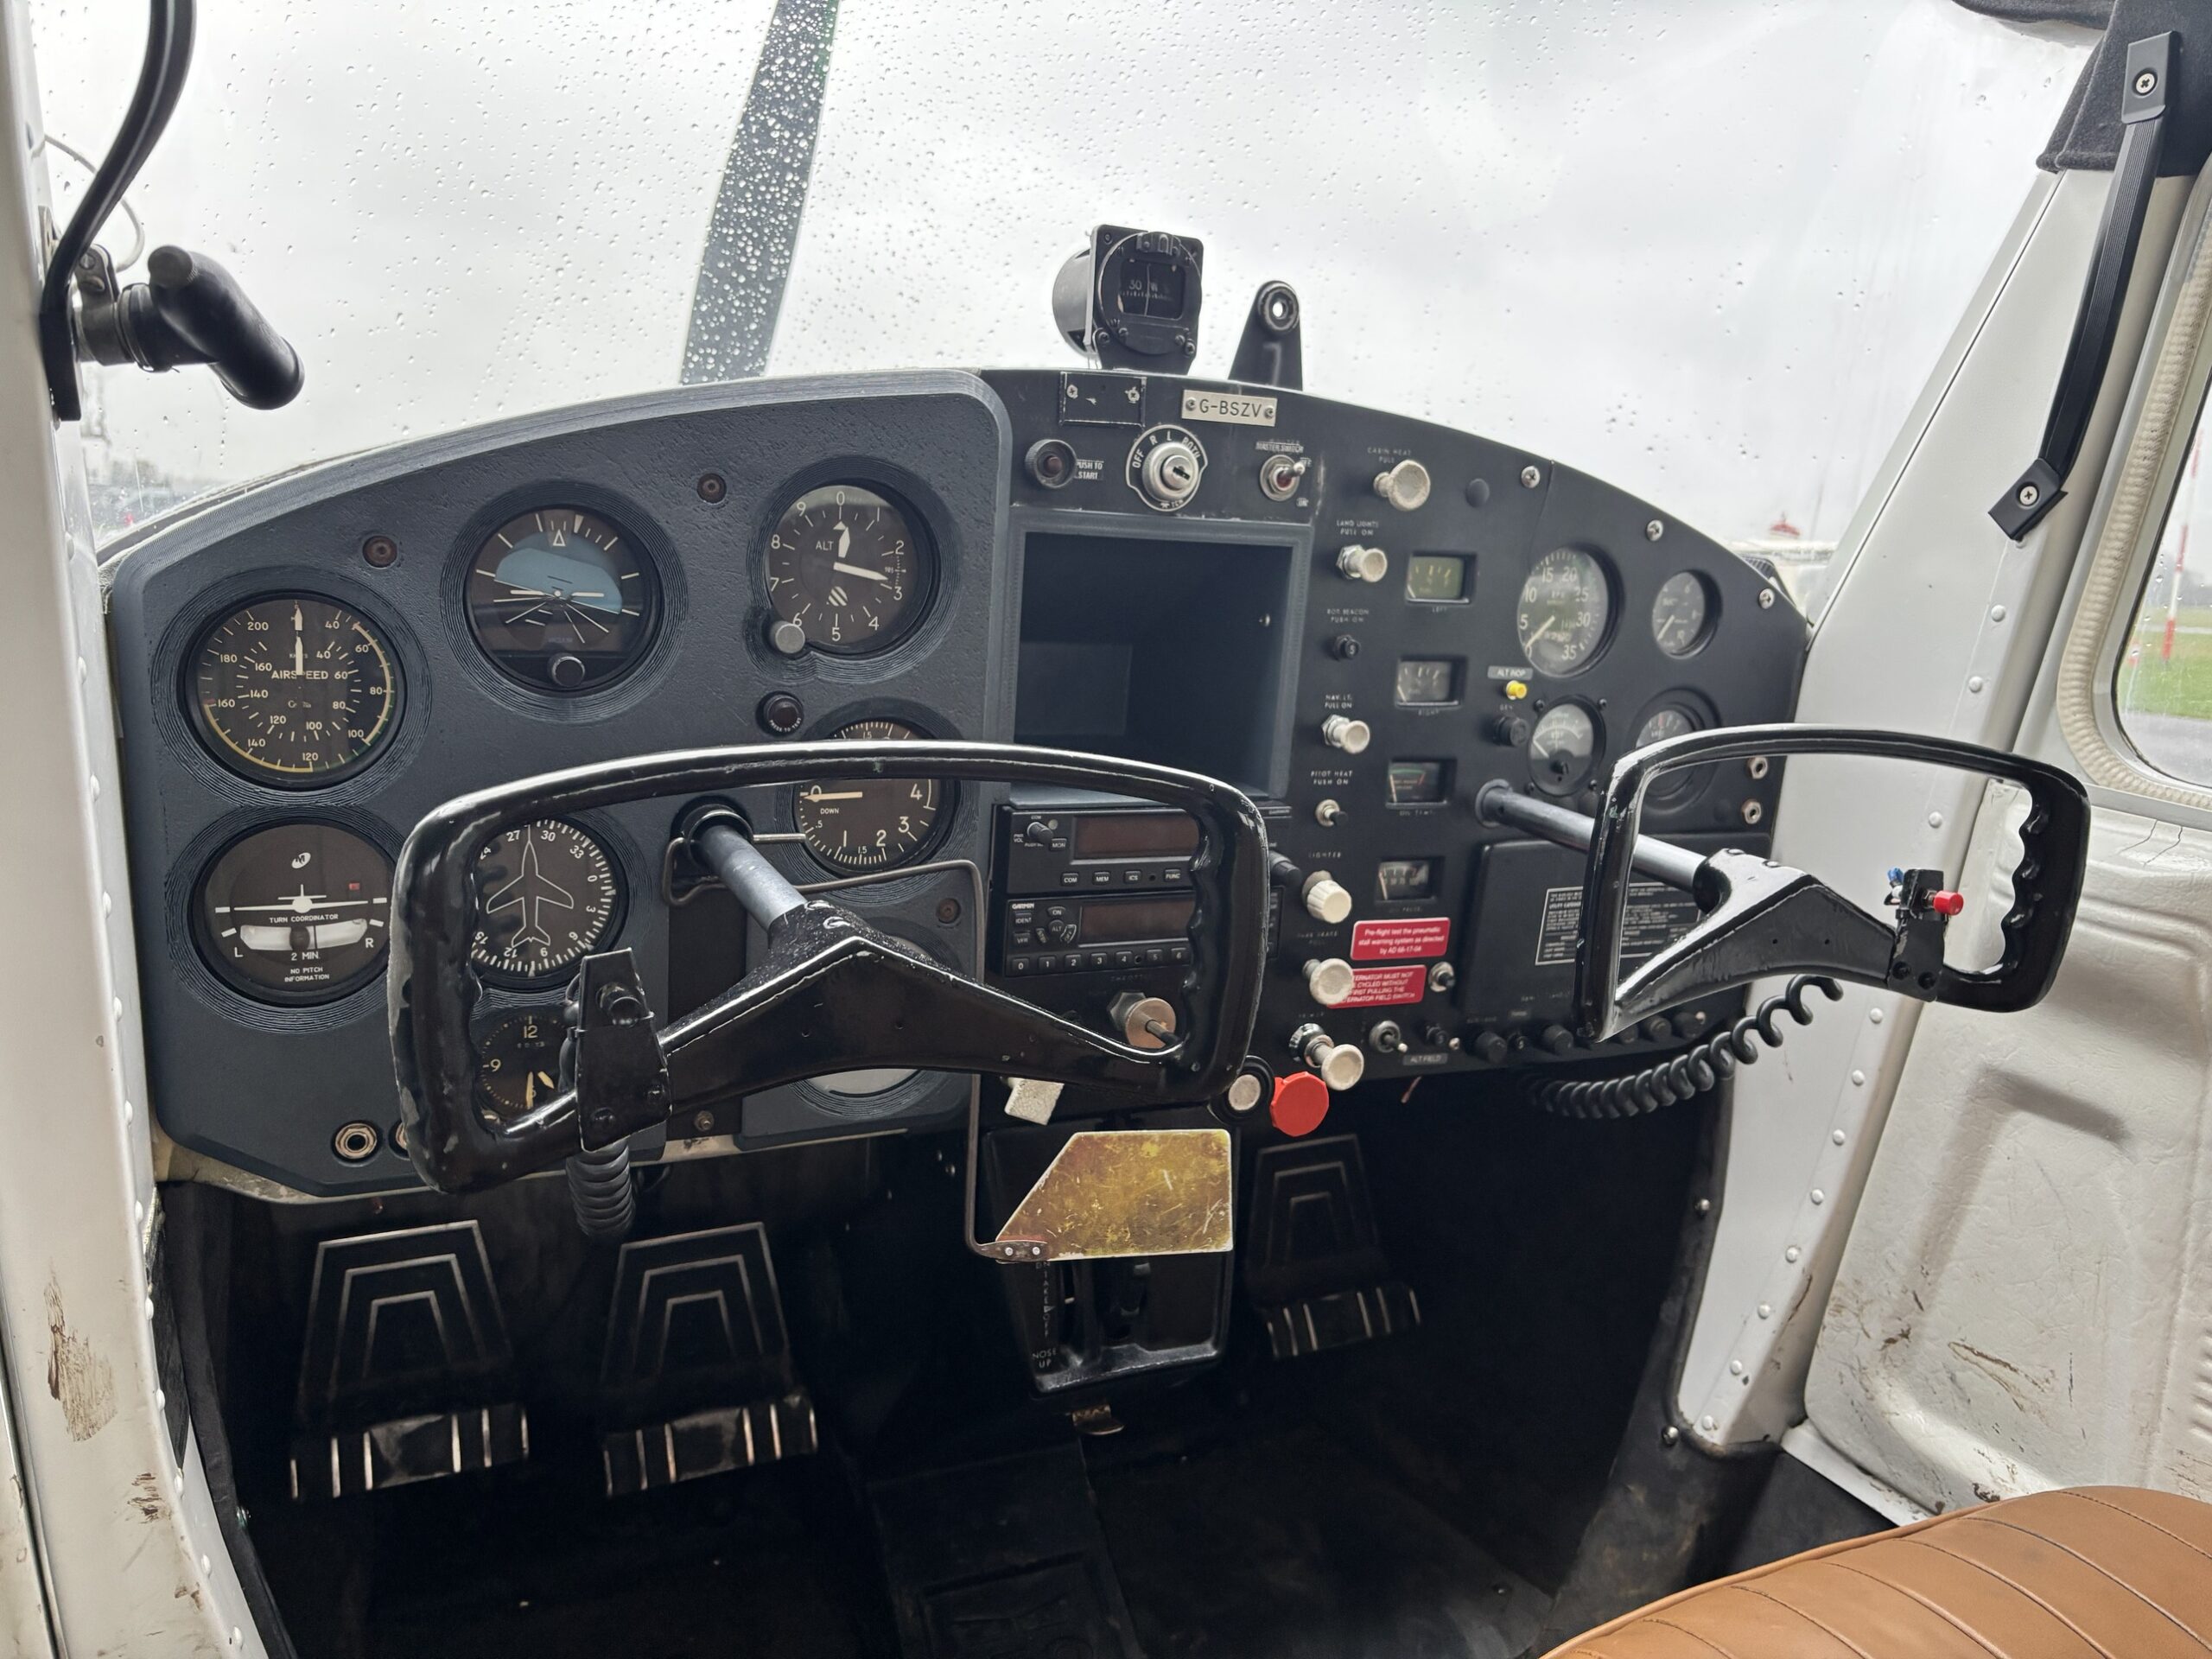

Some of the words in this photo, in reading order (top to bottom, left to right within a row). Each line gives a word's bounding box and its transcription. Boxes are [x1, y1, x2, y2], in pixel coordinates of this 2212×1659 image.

[1128, 280, 1141, 291] 30
[1198, 399, 1263, 418] G-BSZV
[1149, 435, 1159, 446] R
[1166, 430, 1173, 442] L
[1181, 435, 1202, 459] BOTH
[1367, 447, 1390, 455] CABIN
[1131, 448, 1145, 468] OFF
[1077, 471, 1098, 480] START
[836, 490, 846, 506] 0
[796, 501, 807, 517] 9
[1336, 519, 1355, 528] LAND
[770, 533, 781, 550] 8
[815, 540, 835, 551] ALT
[894, 540, 905, 556] 2
[1541, 566, 1554, 583] 15
[1561, 566, 1578, 582] 20
[769, 576, 779, 592] 7
[893, 586, 904, 601] 3
[1524, 586, 1538, 603] 10
[1574, 587, 1590, 602] 25
[325, 620, 340, 629] 40
[791, 612, 803, 627] 6
[868, 615, 880, 631] 4
[1519, 613, 1529, 630] 5
[1575, 612, 1591, 627] 30
[247, 621, 269, 631] 200
[831, 626, 842, 642] 5
[355, 644, 369, 652] 60
[1561, 645, 1578, 661] 35
[220, 654, 238, 663] 180
[316, 650, 331, 659] 40
[255, 662, 272, 671] 160
[334, 671, 348, 680] 60
[370, 686, 383, 696] 80
[218, 699, 235, 708] 160
[270, 715, 286, 724] 120
[306, 721, 322, 730] 100
[347, 729, 364, 738] 100
[248, 739, 266, 747] 140
[302, 753, 319, 761] 120
[910, 783, 923, 801] 4
[898, 816, 910, 833] 3
[505, 830, 521, 842] 27
[540, 830, 556, 842] 30
[875, 830, 887, 848] 2
[569, 845, 585, 860] 33
[585, 905, 596, 913] 3
[290, 912, 340, 923] COORDINATOR
[1364, 927, 1391, 937] Pre-flight
[1413, 926, 1441, 935] pneumatic
[365, 938, 374, 949] R
[474, 931, 489, 945] 15
[1394, 938, 1414, 946] system
[1422, 935, 1446, 944] directed
[234, 946, 244, 958] L
[290, 952, 298, 962] 2
[302, 950, 321, 961] MIN.
[503, 946, 518, 958] 12
[1018, 962, 1024, 970] 0
[1071, 958, 1077, 967] 2
[1096, 957, 1103, 965] 3
[283, 974, 330, 982] INFORMATION
[1357, 980, 1381, 988] CYCLED
[1382, 978, 1409, 987] WITHOUT
[1393, 985, 1406, 994] THE
[1375, 993, 1392, 1001] FIELD
[524, 1025, 538, 1039] 12
[490, 1058, 502, 1072] 9
[1410, 1055, 1424, 1064] ALT
[1424, 1054, 1442, 1063] FIELD
[1031, 1347, 1057, 1359] NOSE
[1039, 1357, 1052, 1369] UP
